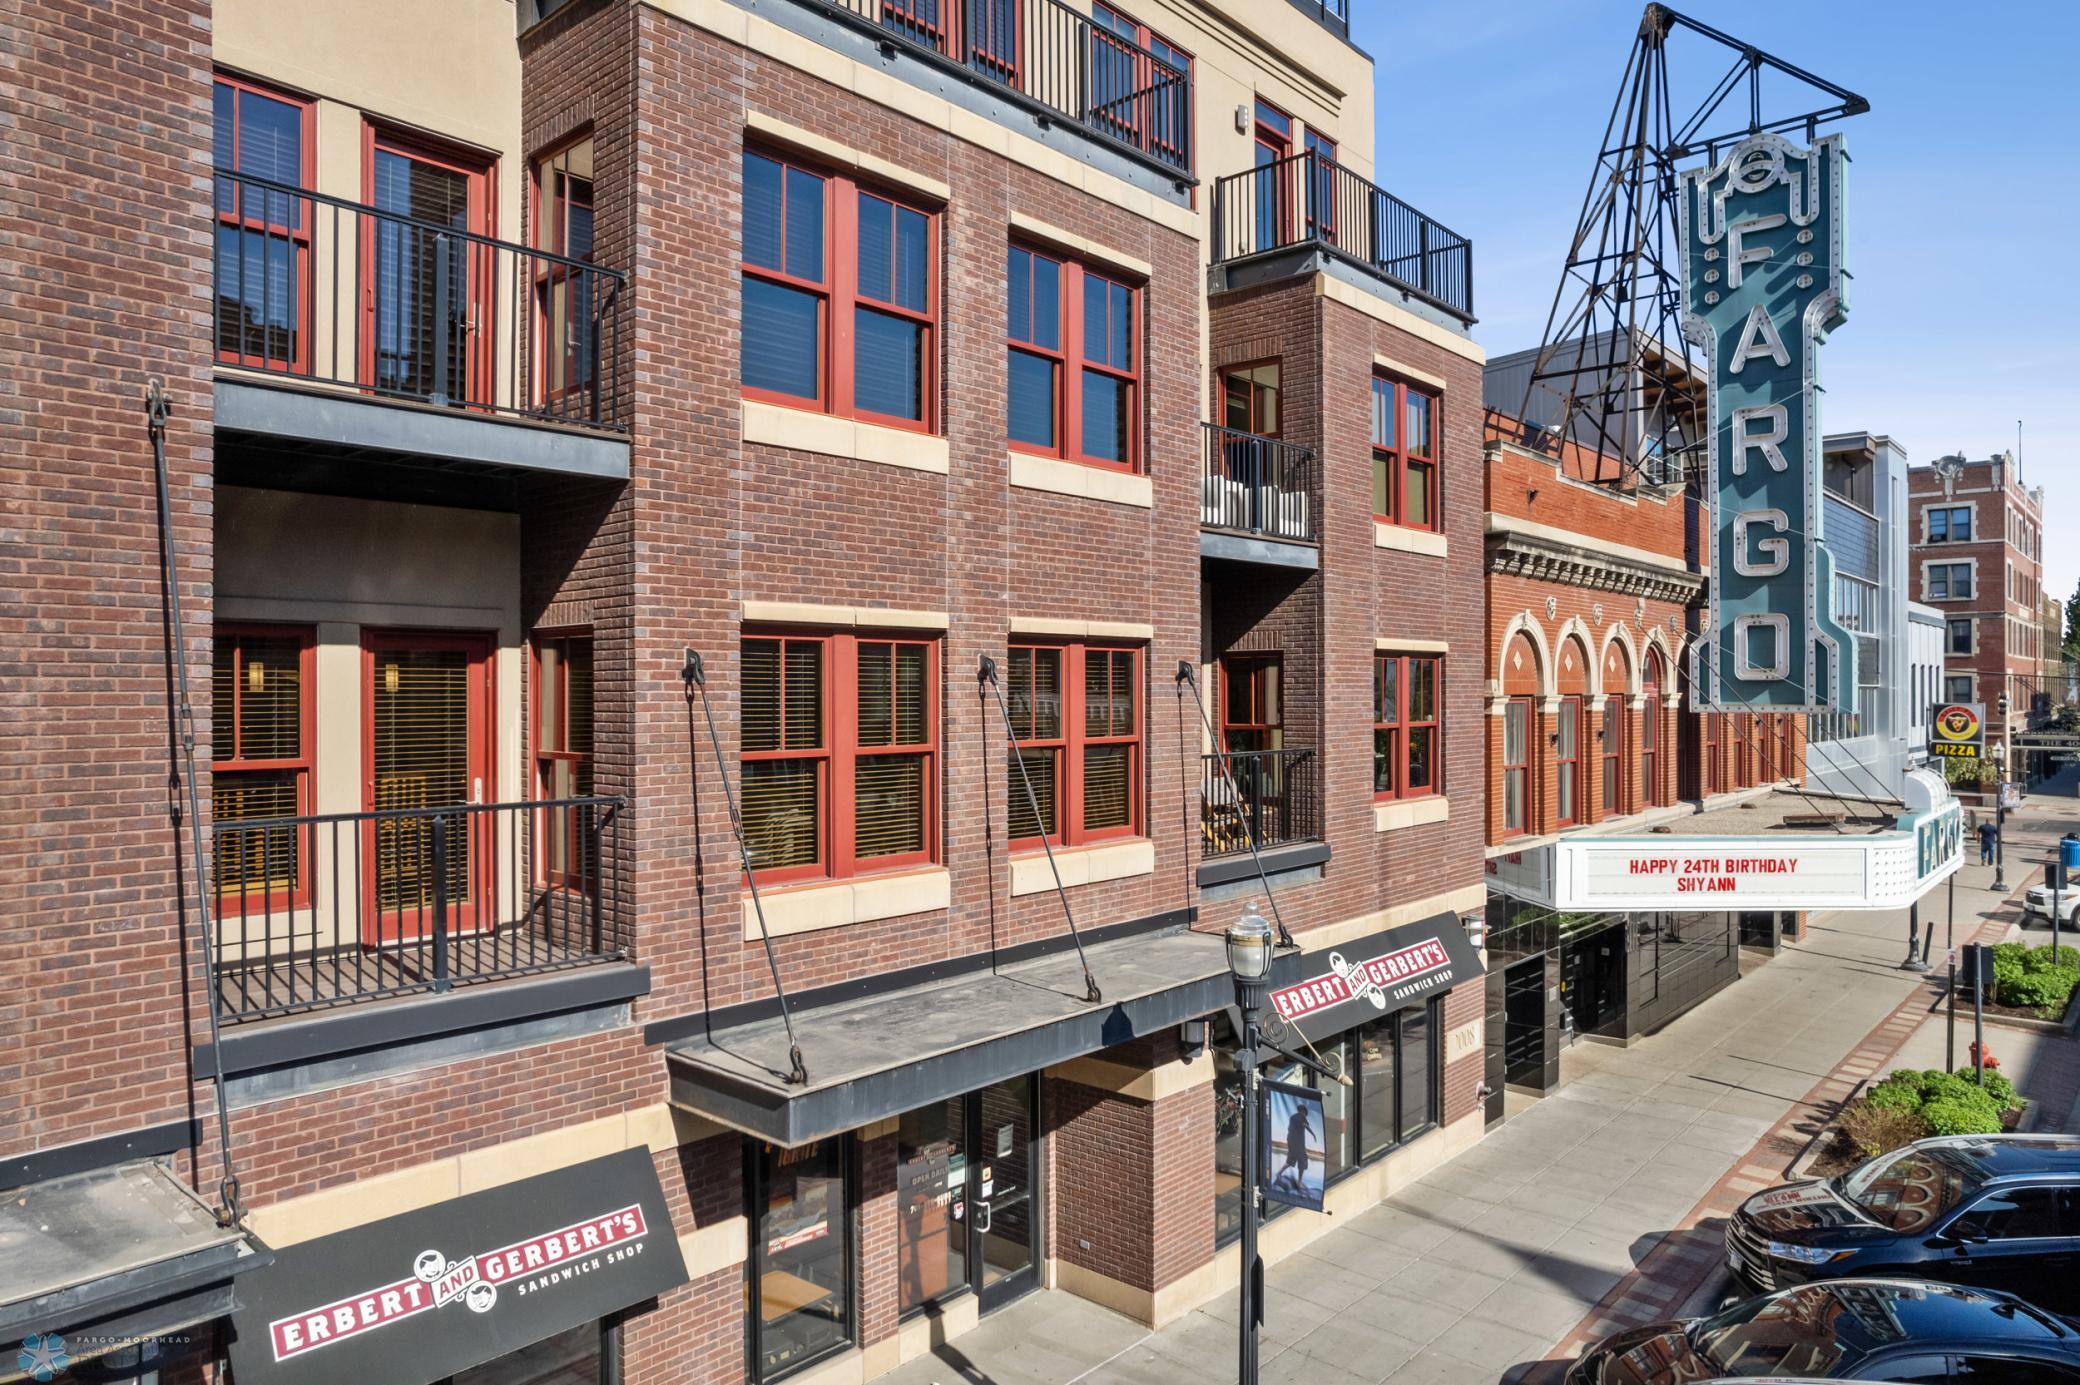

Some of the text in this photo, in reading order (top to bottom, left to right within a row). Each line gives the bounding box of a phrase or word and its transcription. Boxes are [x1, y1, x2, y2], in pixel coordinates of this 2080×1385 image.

[1727, 213, 1792, 682] FARGO
[1935, 744, 1976, 757] PIZZA
[1629, 858, 1798, 874] HAPPY 24TH BIRTHDAY
[1921, 813, 1961, 876] FARGO
[1677, 877, 1736, 892] SHYANN
[1276, 943, 1444, 1016] ERBERT AND GERBERT'S
[1393, 970, 1453, 1000] SANDWICH SHOP
[281, 1212, 638, 1351] ERBERT AND GERBERT'S
[518, 1243, 645, 1296] SANDWICH SHOP
